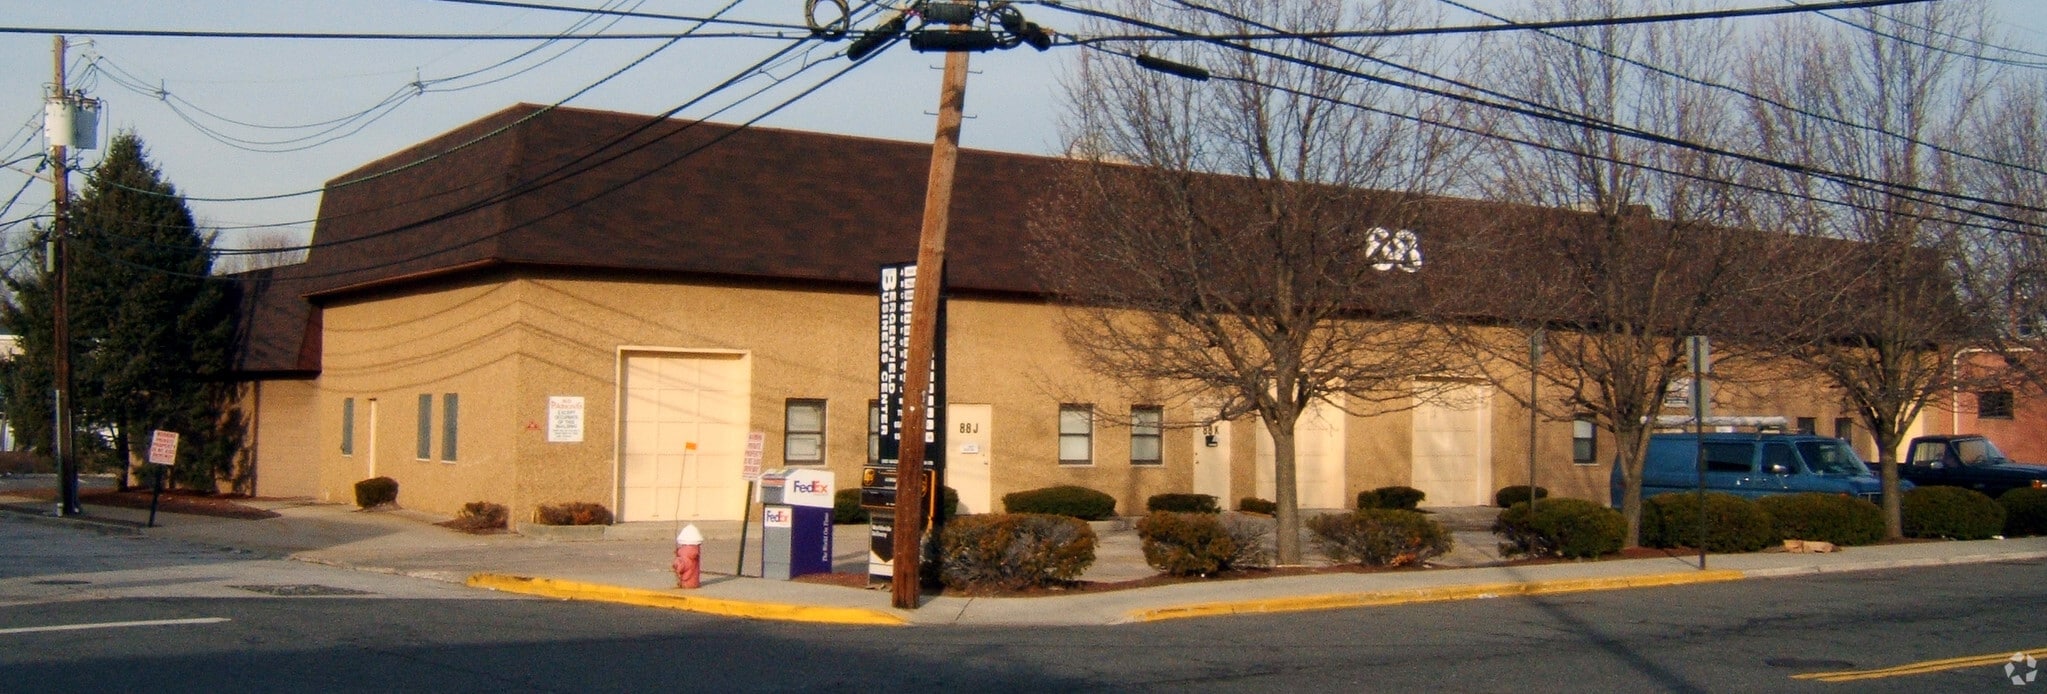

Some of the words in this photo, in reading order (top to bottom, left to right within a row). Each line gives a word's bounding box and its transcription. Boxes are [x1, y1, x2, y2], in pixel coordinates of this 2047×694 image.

[881, 371, 889, 435] CENTER
[793, 480, 828, 493] FedEx
[766, 510, 789, 523] FedEx
